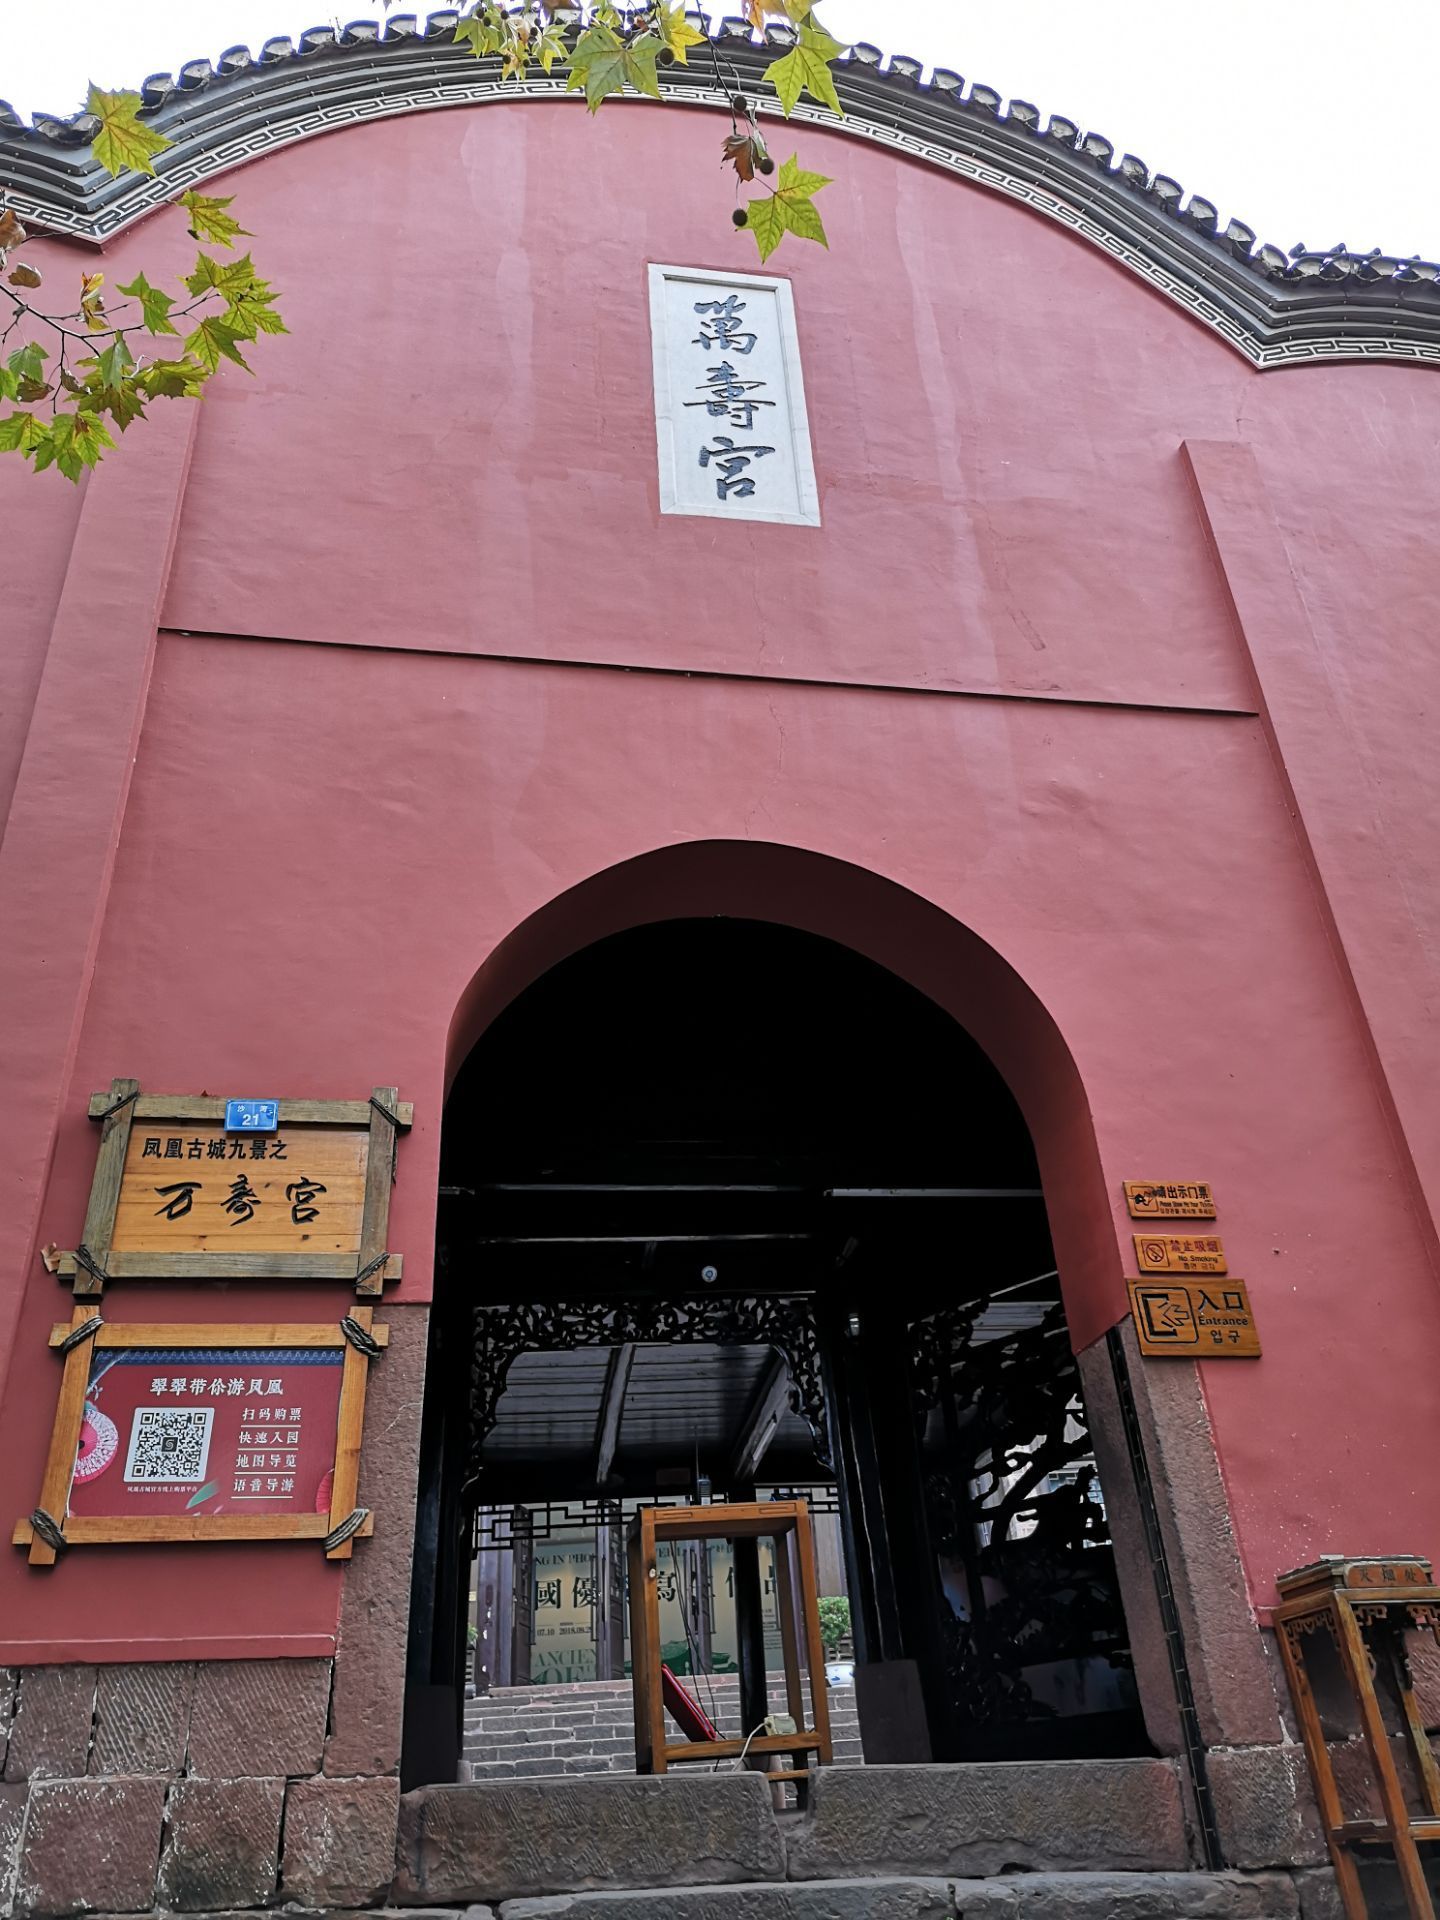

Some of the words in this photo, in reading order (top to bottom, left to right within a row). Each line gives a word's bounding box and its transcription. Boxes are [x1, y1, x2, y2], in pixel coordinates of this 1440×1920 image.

[242, 1114, 259, 1126] 21
[142, 1137, 288, 1161] 凤凰古城九景之
[1169, 1239, 1219, 1253] 禁止吸烟
[1190, 1255, 1218, 1264] Smoking
[1197, 1289, 1245, 1311] 入口
[1198, 1315, 1249, 1326] Entrance
[1210, 1329, 1241, 1344] 입구
[242, 1407, 302, 1422] 扫码购票
[238, 1430, 299, 1445] 快速入园
[234, 1453, 297, 1469] 地图导览
[233, 1477, 295, 1493] 语音导游
